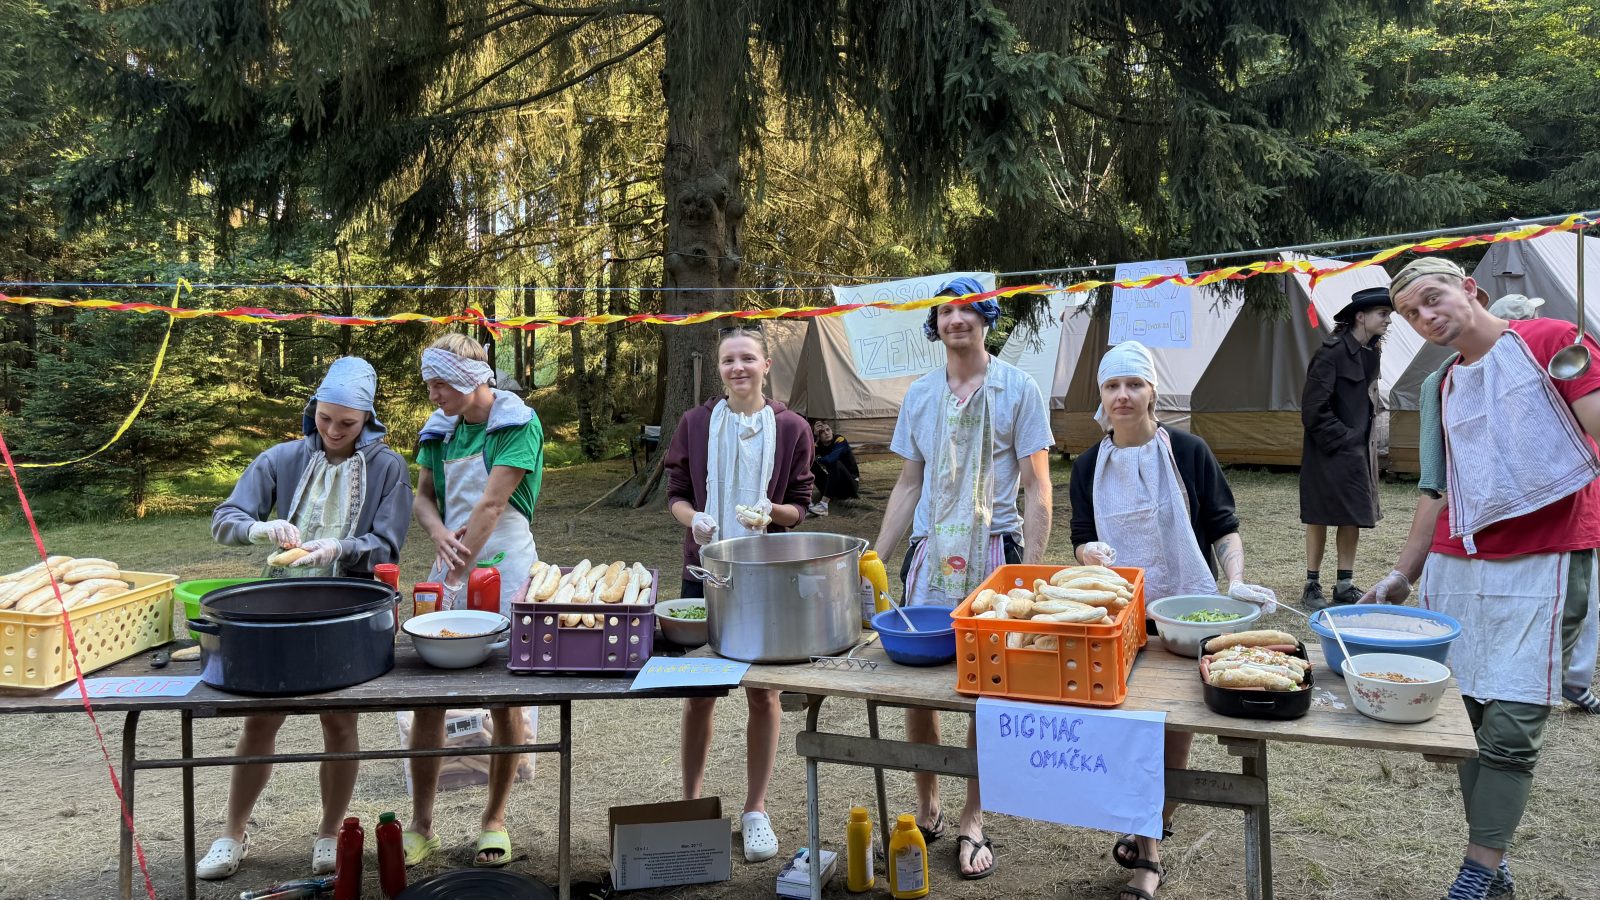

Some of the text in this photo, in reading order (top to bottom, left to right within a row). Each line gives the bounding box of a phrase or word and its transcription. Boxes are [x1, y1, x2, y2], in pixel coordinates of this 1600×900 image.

[854, 326, 944, 375] ZENI
[999, 712, 1084, 743] BIG MAC
[1029, 747, 1108, 774] OMÁČKA
